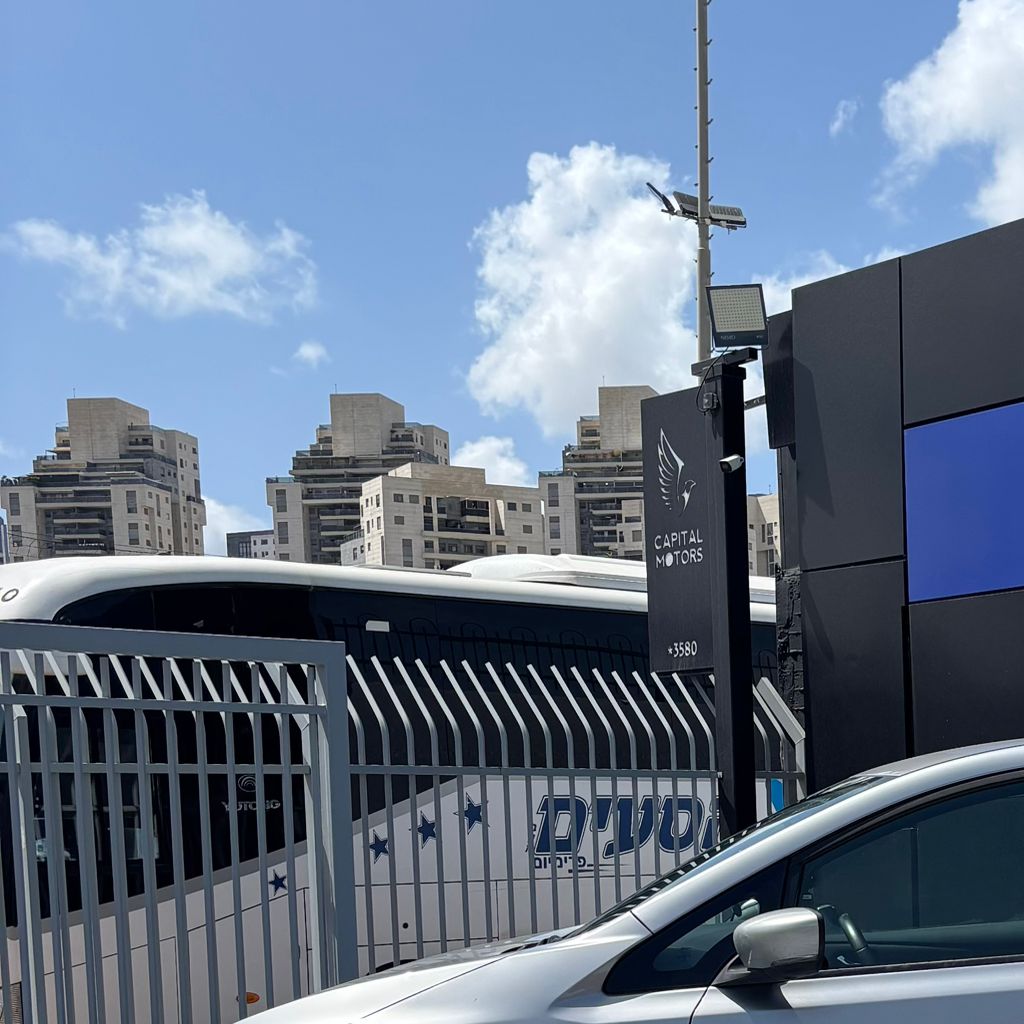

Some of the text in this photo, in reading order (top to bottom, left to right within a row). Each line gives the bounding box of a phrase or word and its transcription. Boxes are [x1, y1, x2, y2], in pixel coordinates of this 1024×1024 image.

[654, 528, 704, 550] CAPITAL
[655, 547, 704, 569] MOTORS
[534, 794, 720, 860] סעים
